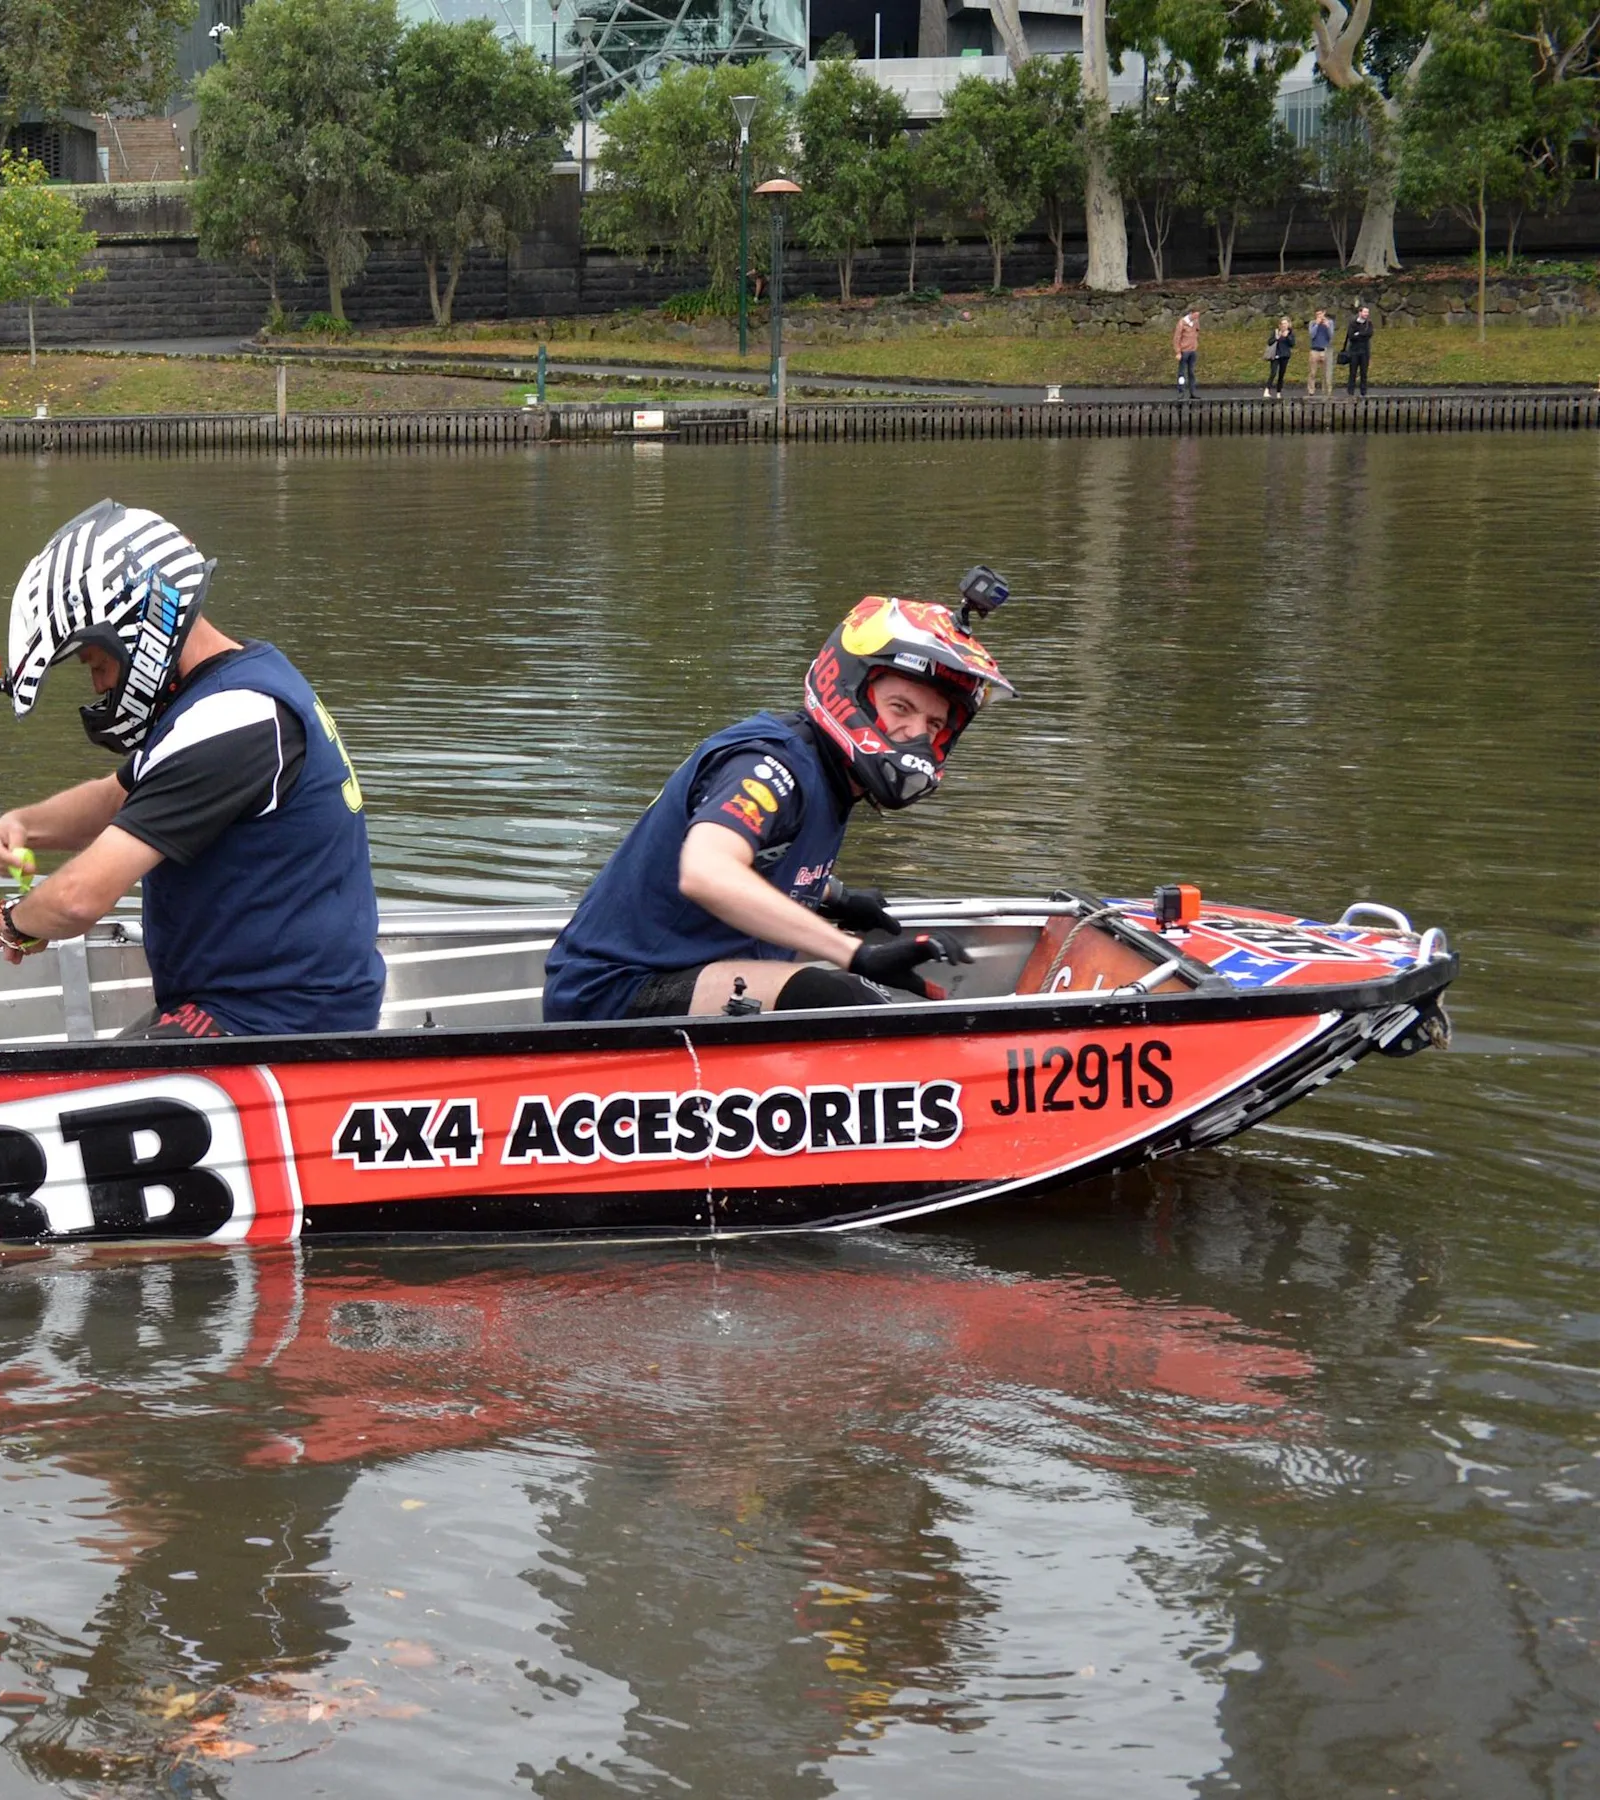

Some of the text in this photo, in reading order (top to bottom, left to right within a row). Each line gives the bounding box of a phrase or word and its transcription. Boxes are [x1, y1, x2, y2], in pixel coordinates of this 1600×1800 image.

[990, 1040, 1174, 1117] JI291S
[335, 1081, 961, 1167] 4X4 ACCESSORIES
